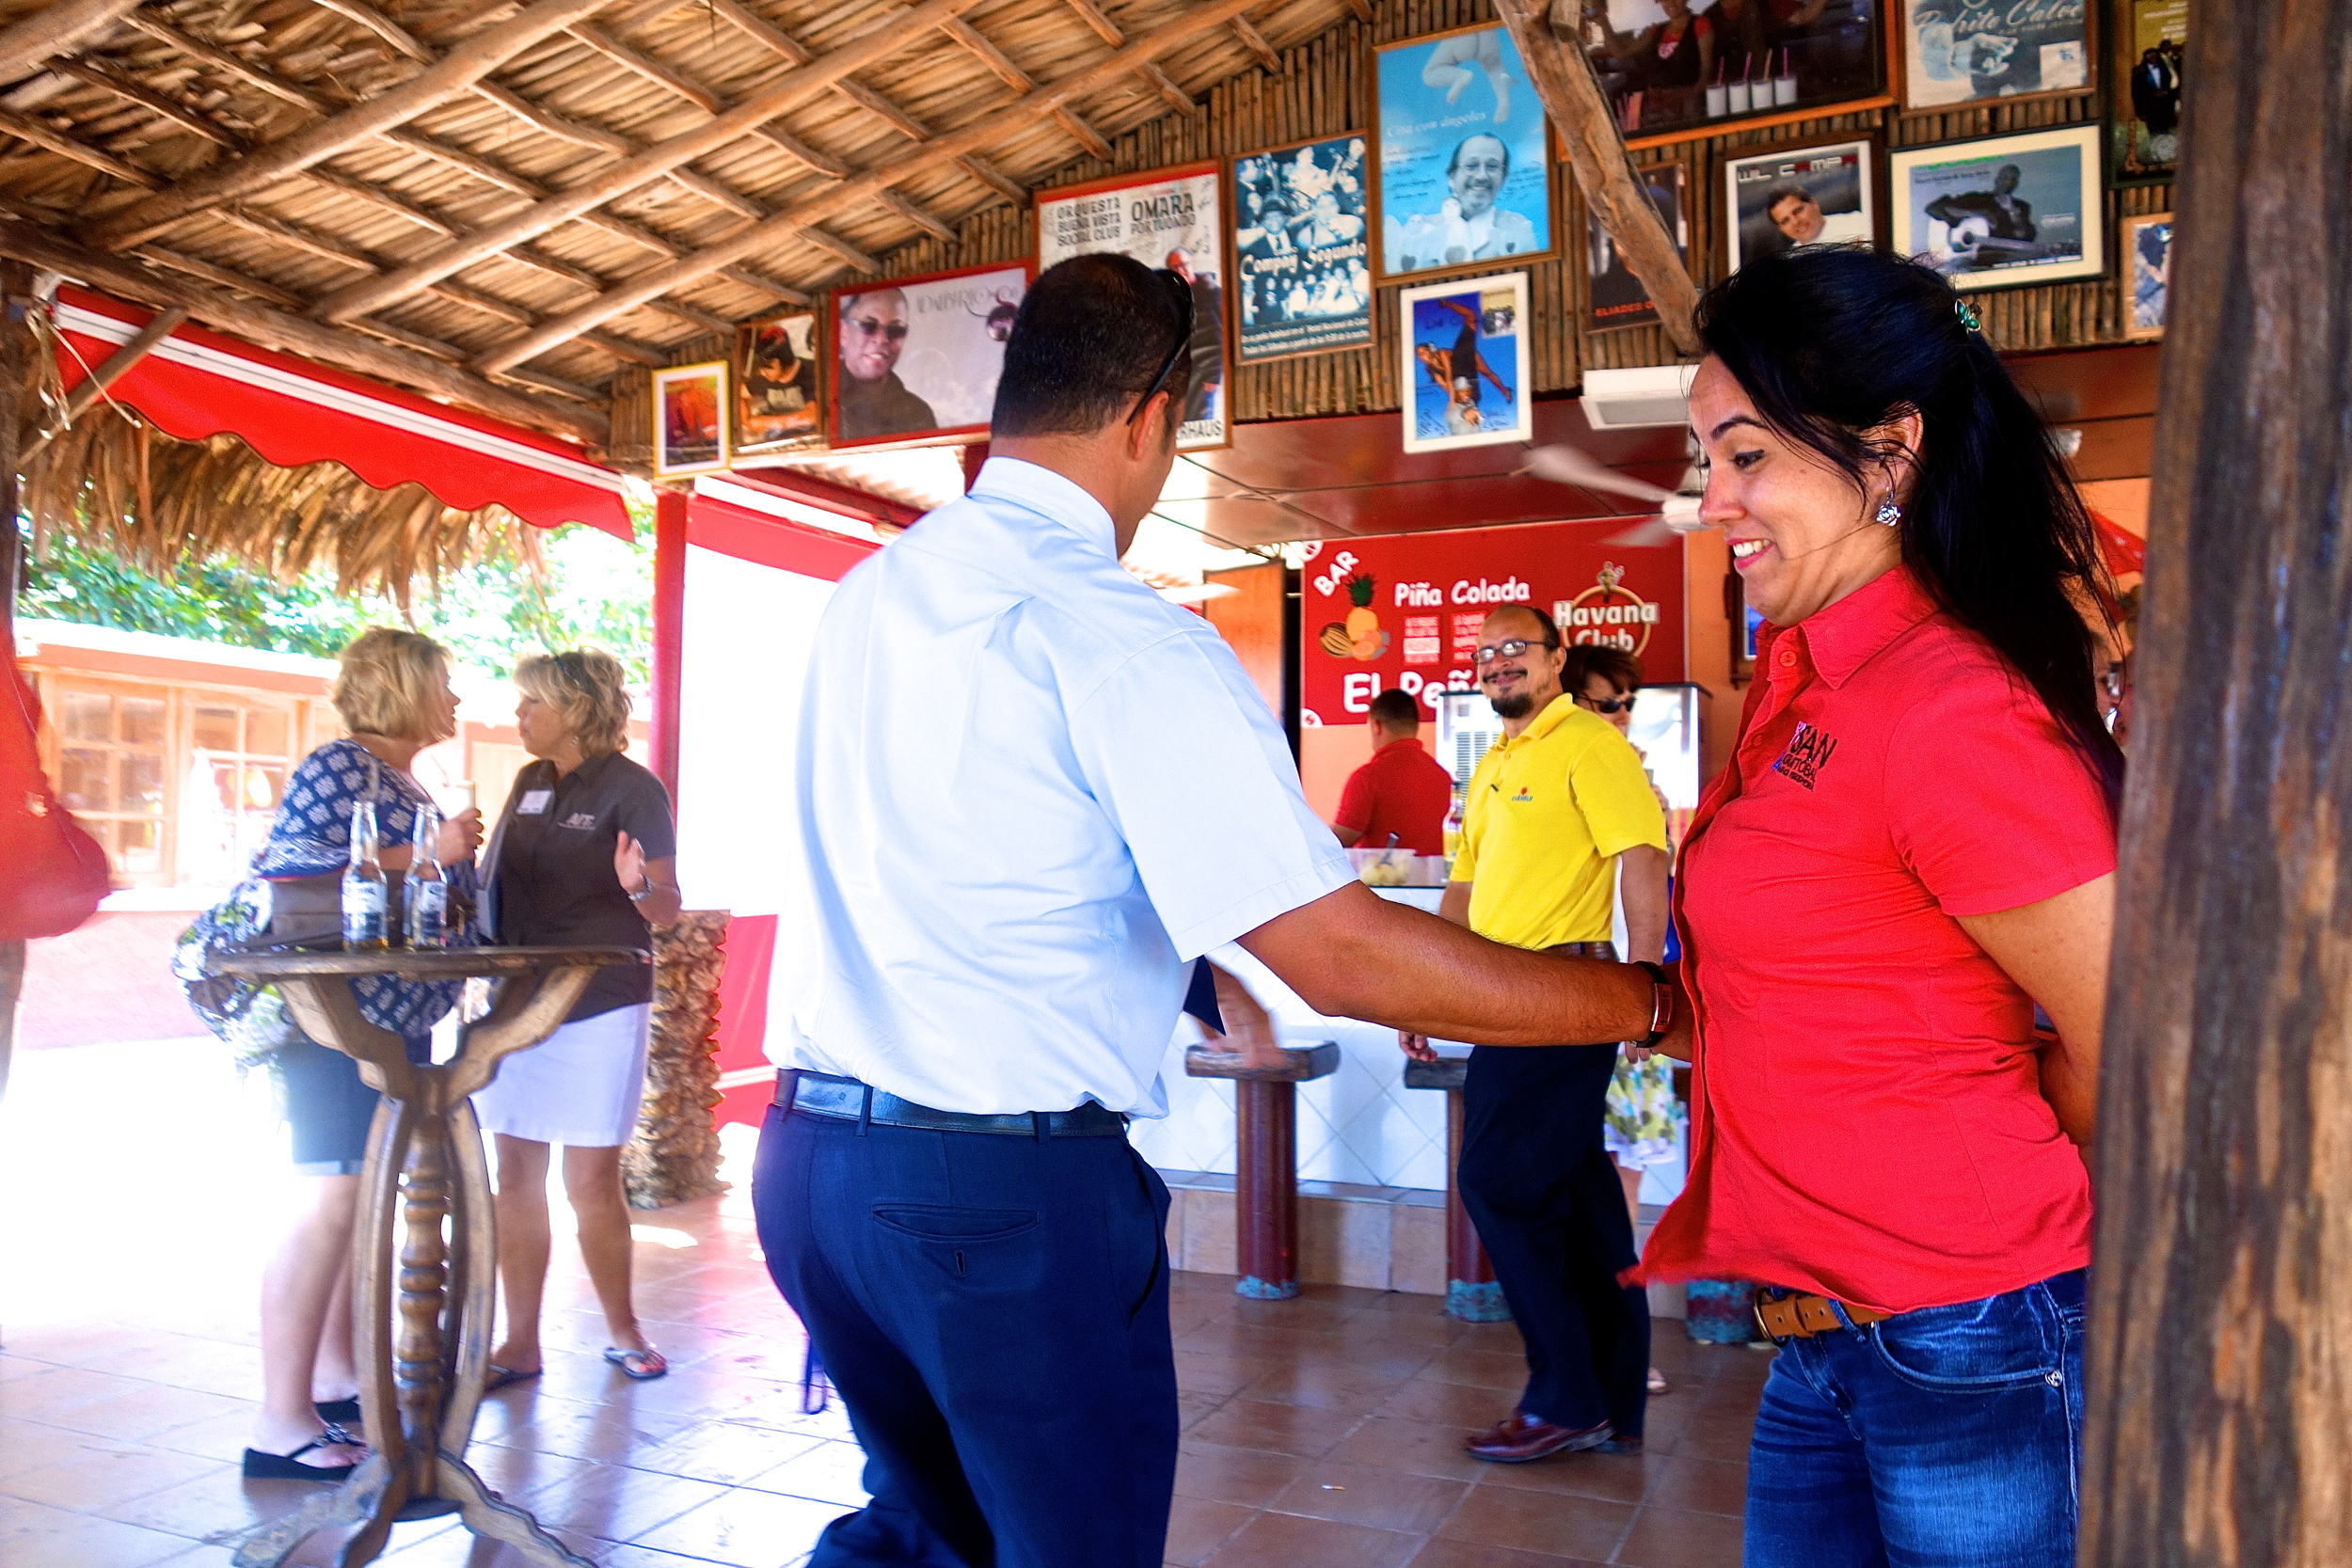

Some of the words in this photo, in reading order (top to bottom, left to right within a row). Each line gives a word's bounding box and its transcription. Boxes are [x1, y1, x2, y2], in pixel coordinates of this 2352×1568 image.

[1057, 197, 1121, 220] ORQUESTA
[1092, 212, 1121, 228] VISTA
[1131, 192, 1195, 222] OMARA
[1093, 226, 1121, 241] CLUB
[1240, 247, 1298, 281] Compay
[1302, 238, 1367, 271] Segundo
[1313, 550, 1359, 597] BAR
[1394, 581, 1443, 607] Piña
[1451, 575, 1532, 605] Colada
[1553, 599, 1660, 629] Havana
[1343, 673, 1382, 713] El
[1400, 669, 1482, 708] Peñ
[1789, 724, 1838, 769] SAN
